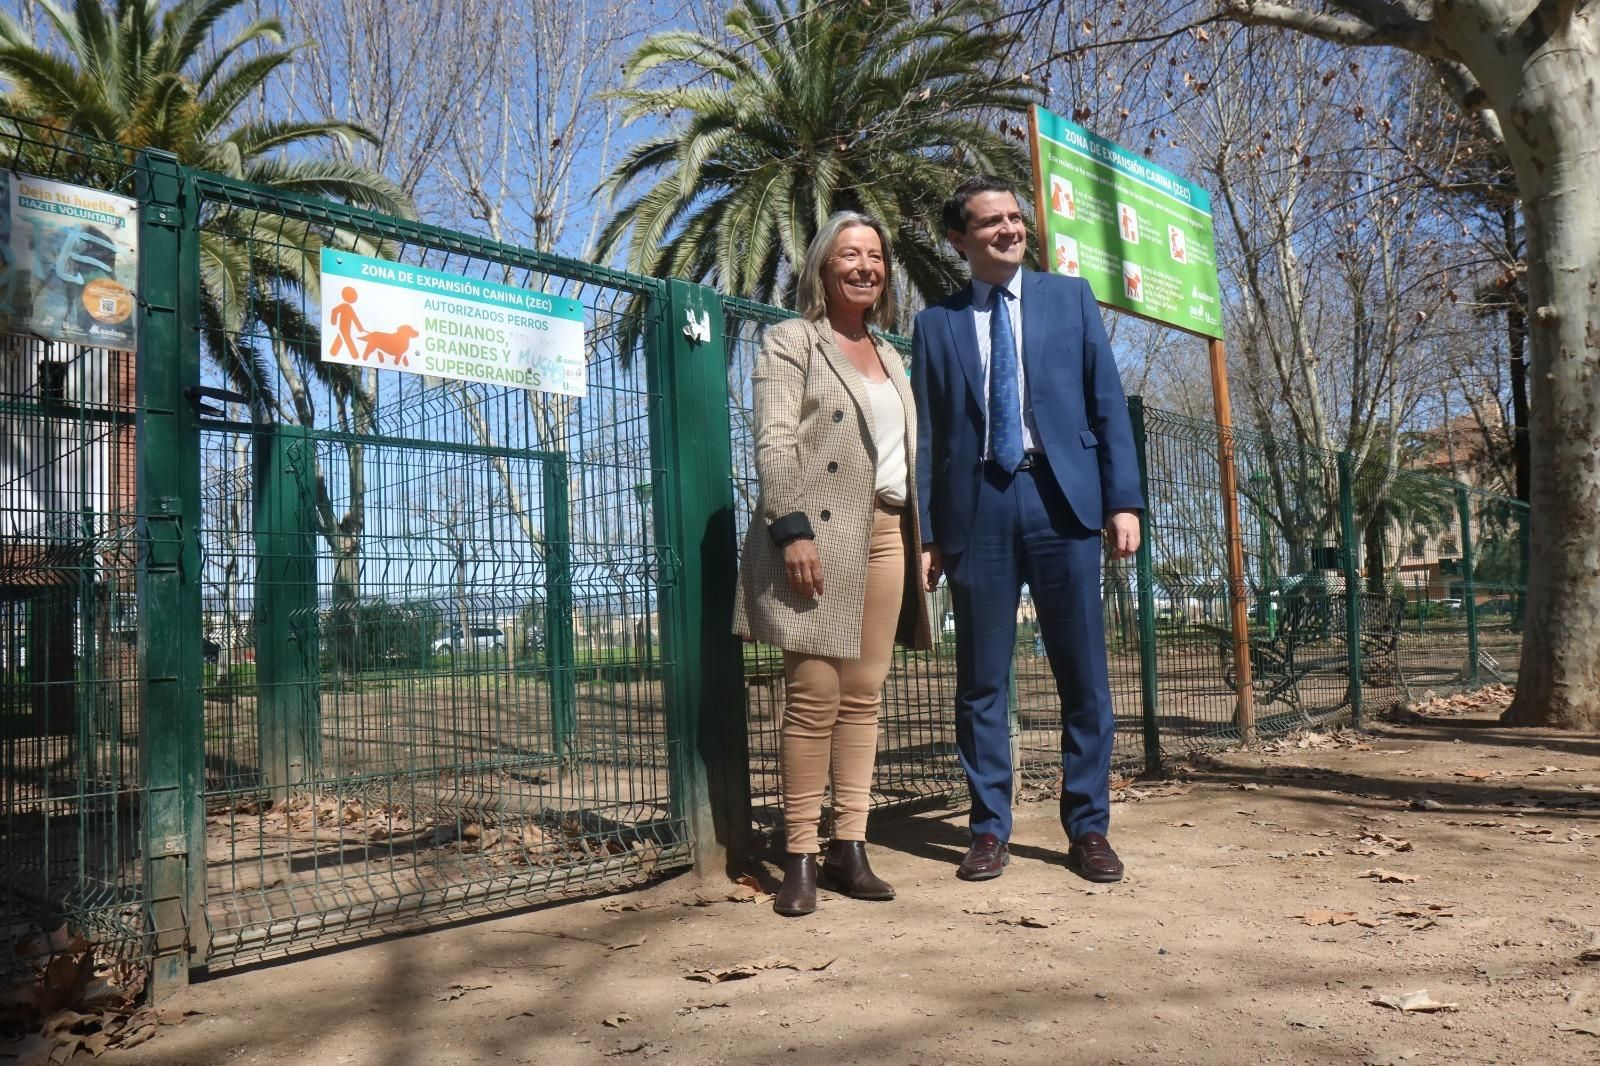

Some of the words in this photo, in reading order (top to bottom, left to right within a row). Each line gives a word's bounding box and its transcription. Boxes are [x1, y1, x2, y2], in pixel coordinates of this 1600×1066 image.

[1064, 128, 1089, 150] ZONA
[1090, 142, 1101, 156] DE
[1102, 144, 1145, 177] EXPANSIÓN
[1145, 168, 1173, 192] CANINA
[1173, 180, 1191, 202] (ZEC)
[19, 183, 52, 201] Deja
[55, 191, 70, 204] tu
[74, 194, 116, 214] huella
[20, 197, 57, 212] HAZTE
[361, 263, 395, 281] ZONA
[397, 270, 414, 284] DE
[416, 274, 480, 297] EXPANSIÓN
[482, 287, 523, 305] CANINA
[525, 295, 553, 313] (ZEC)
[424, 298, 504, 323] AUTORIZADOS
[507, 313, 549, 331] PERROS
[424, 317, 509, 347] MEDIANOS,
[425, 336, 498, 362] GRANDES
[502, 349, 511, 363] Y
[425, 356, 542, 387] SUPERGRANDES
